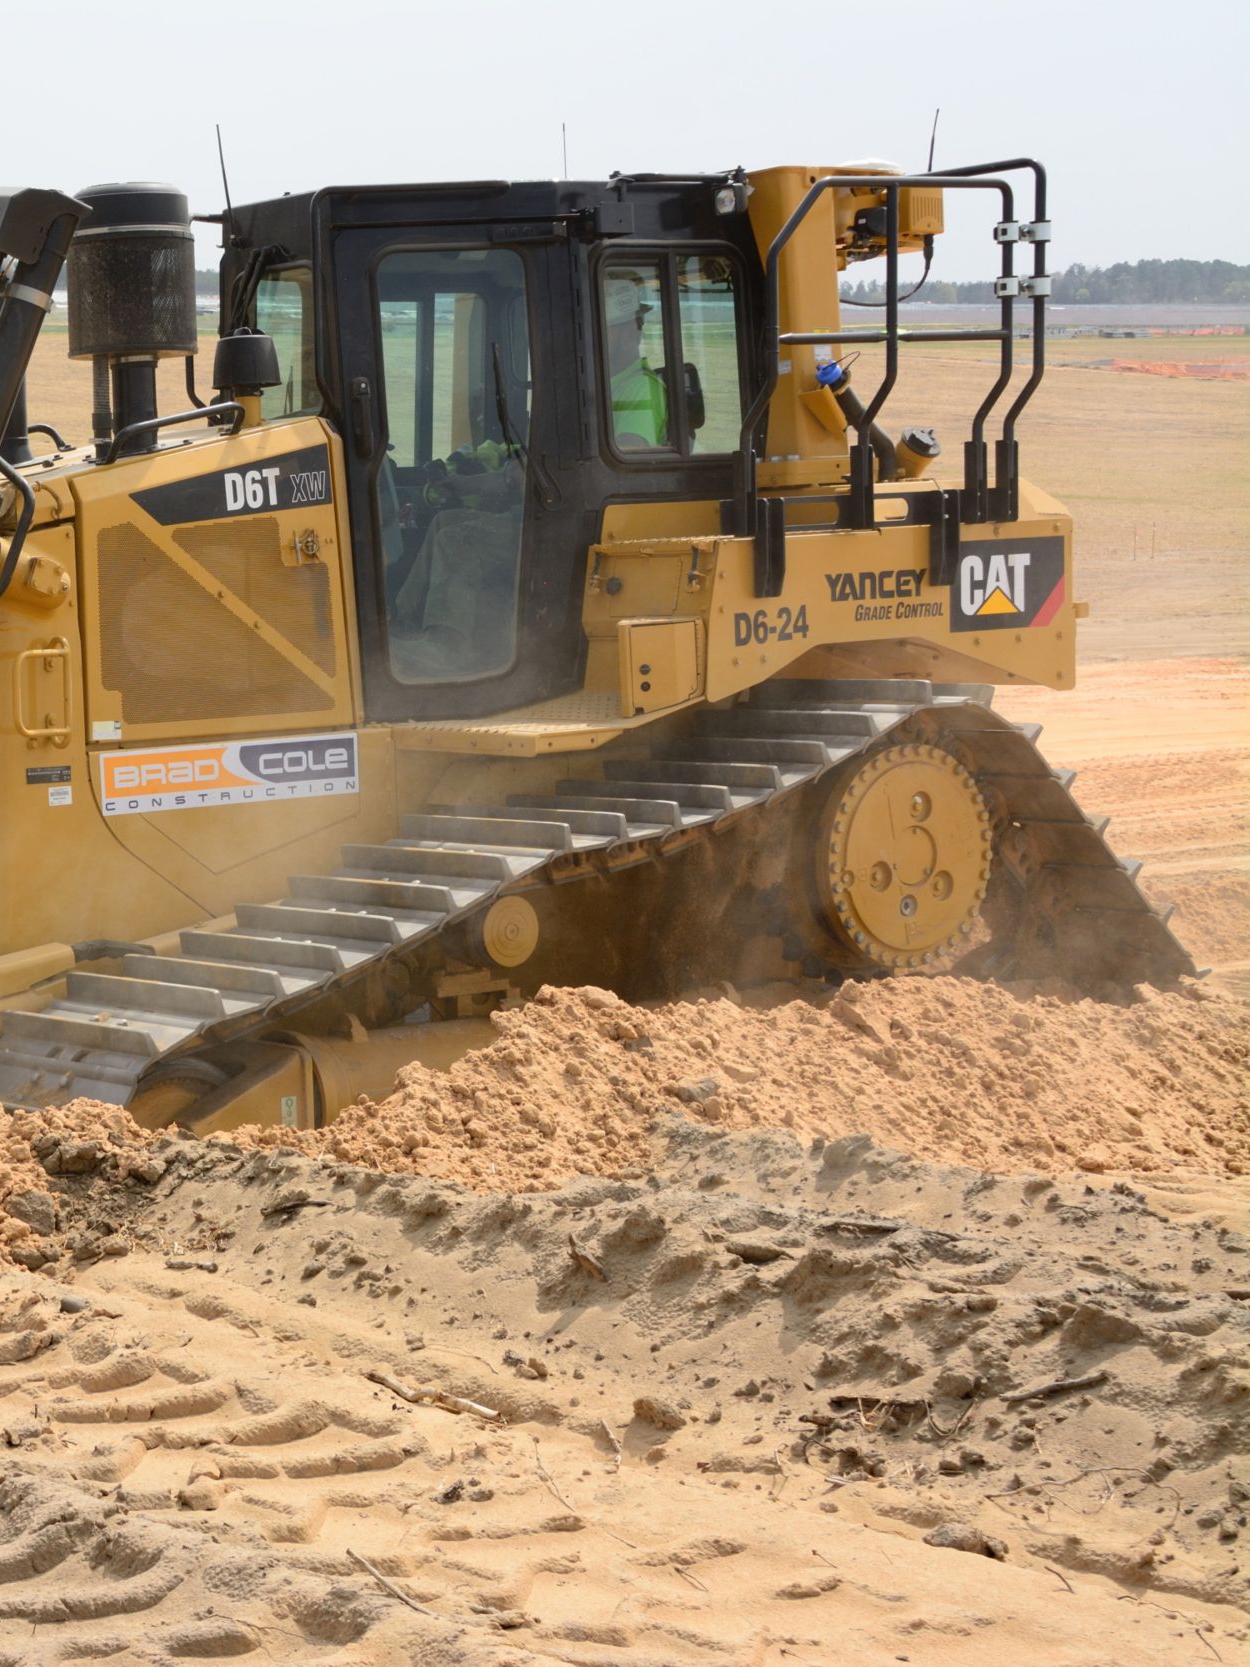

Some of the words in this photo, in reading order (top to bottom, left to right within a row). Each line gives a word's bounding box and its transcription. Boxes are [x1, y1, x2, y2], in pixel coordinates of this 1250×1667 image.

[224, 467, 280, 511] D6T
[290, 470, 326, 503] XW
[825, 568, 927, 602] YANCEY
[960, 553, 1031, 616] CAT
[734, 604, 809, 647] D6-24
[854, 603, 893, 622] GRADE
[895, 601, 944, 620] CONTROL
[105, 780, 356, 812] CONSTRUCTION
